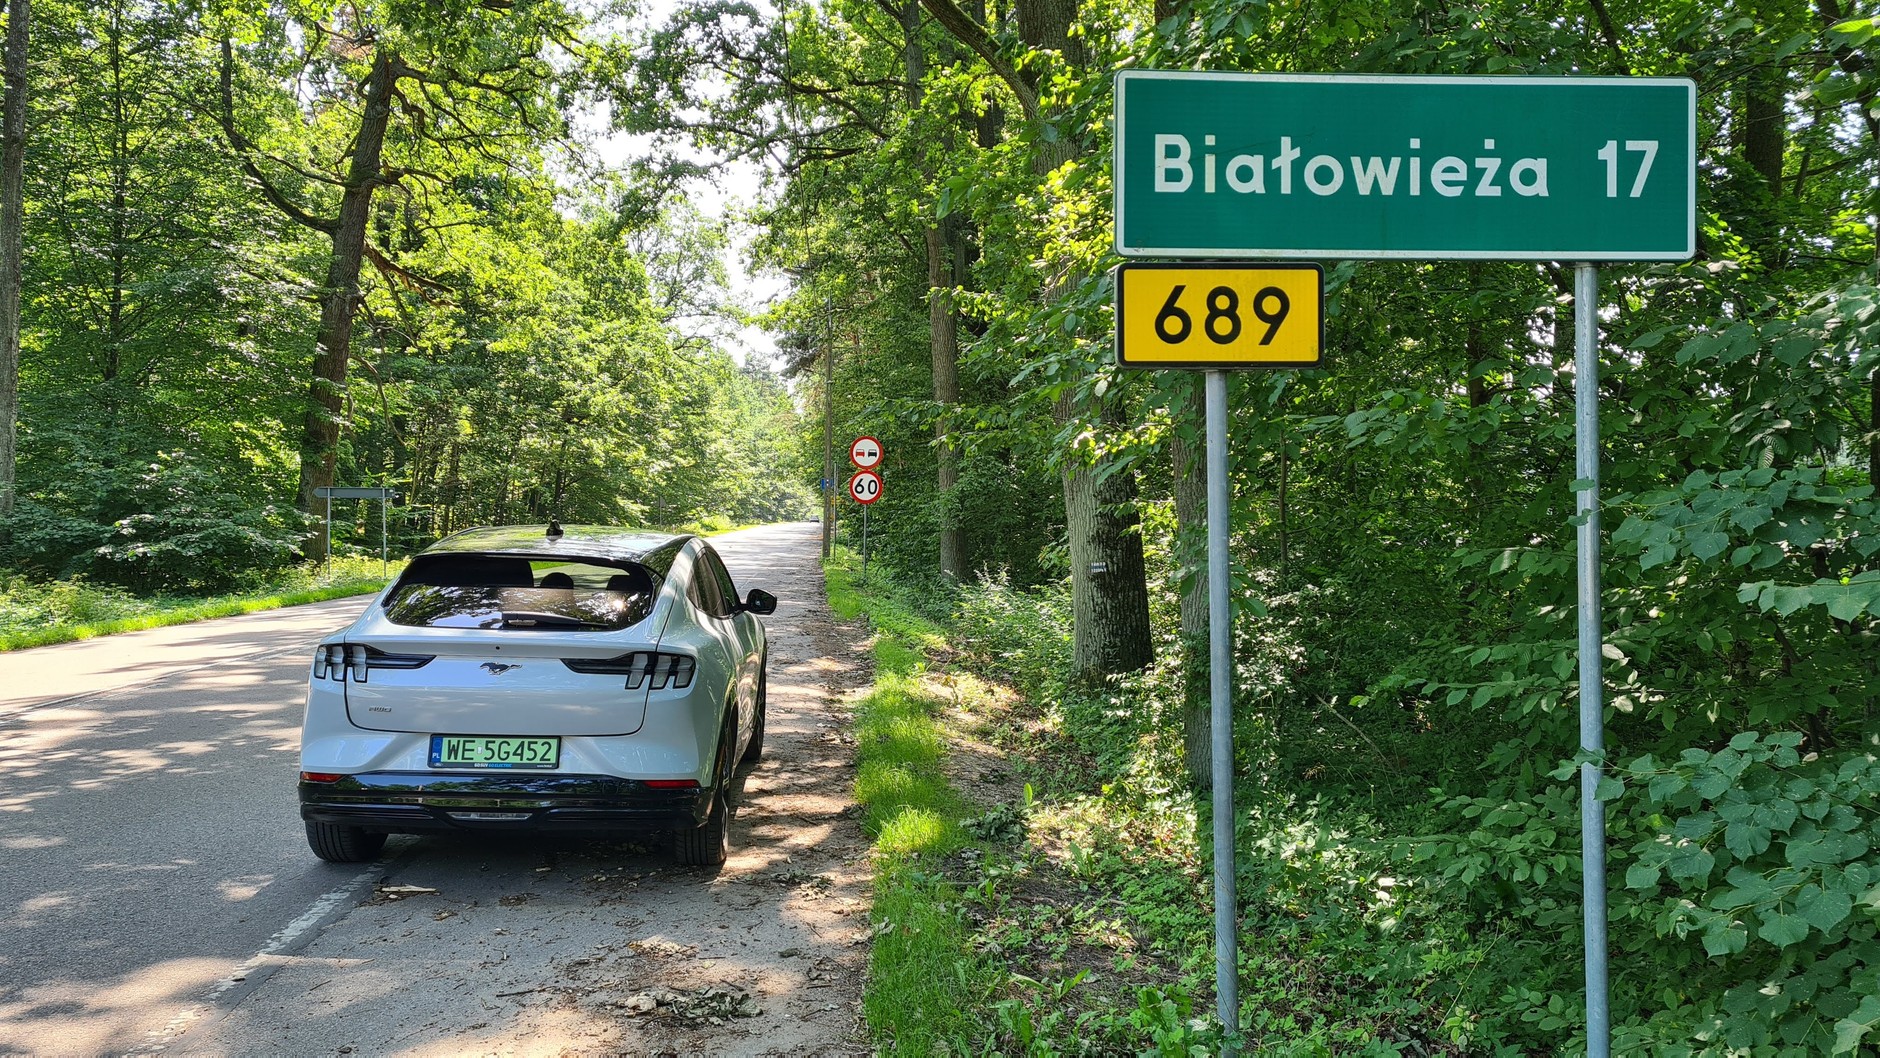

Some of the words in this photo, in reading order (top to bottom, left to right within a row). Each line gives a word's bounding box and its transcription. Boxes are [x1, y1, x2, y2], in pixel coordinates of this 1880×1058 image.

[1154, 133, 1550, 198] Białowieża
[1598, 139, 1660, 198] 17
[1154, 284, 1291, 346] 689
[854, 478, 878, 495] 60
[447, 739, 476, 760] WE
[484, 740, 552, 761] 5G452
